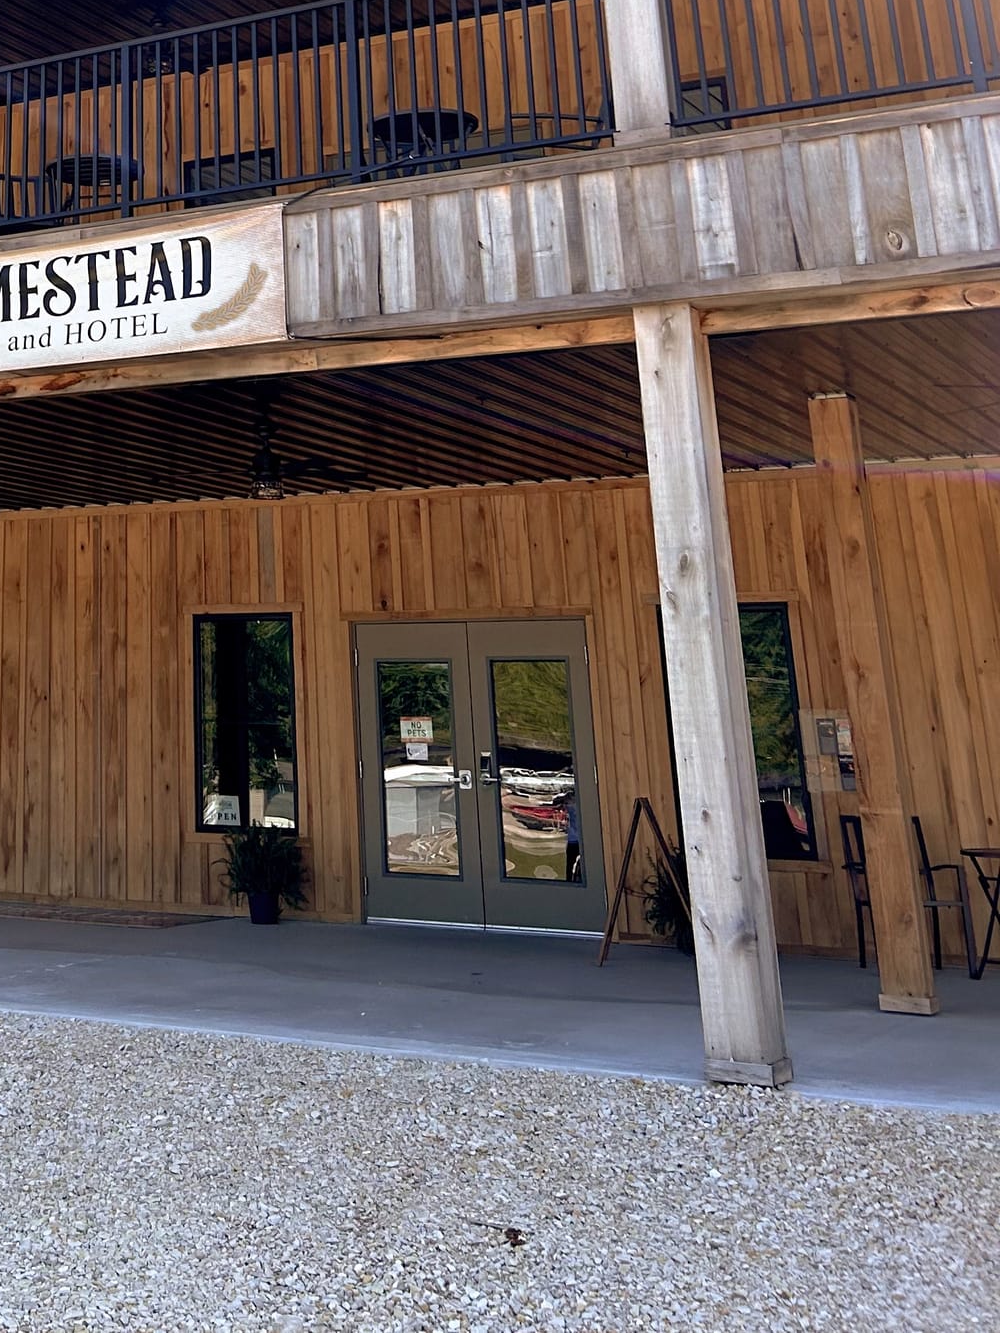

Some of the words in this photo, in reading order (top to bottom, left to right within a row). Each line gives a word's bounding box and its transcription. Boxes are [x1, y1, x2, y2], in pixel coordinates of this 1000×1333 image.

[8, 325, 53, 352] and
[64, 312, 169, 346] HOTEL
[410, 721, 422, 729] NO
[407, 729, 427, 738] PETS
[210, 812, 237, 821] PEN
